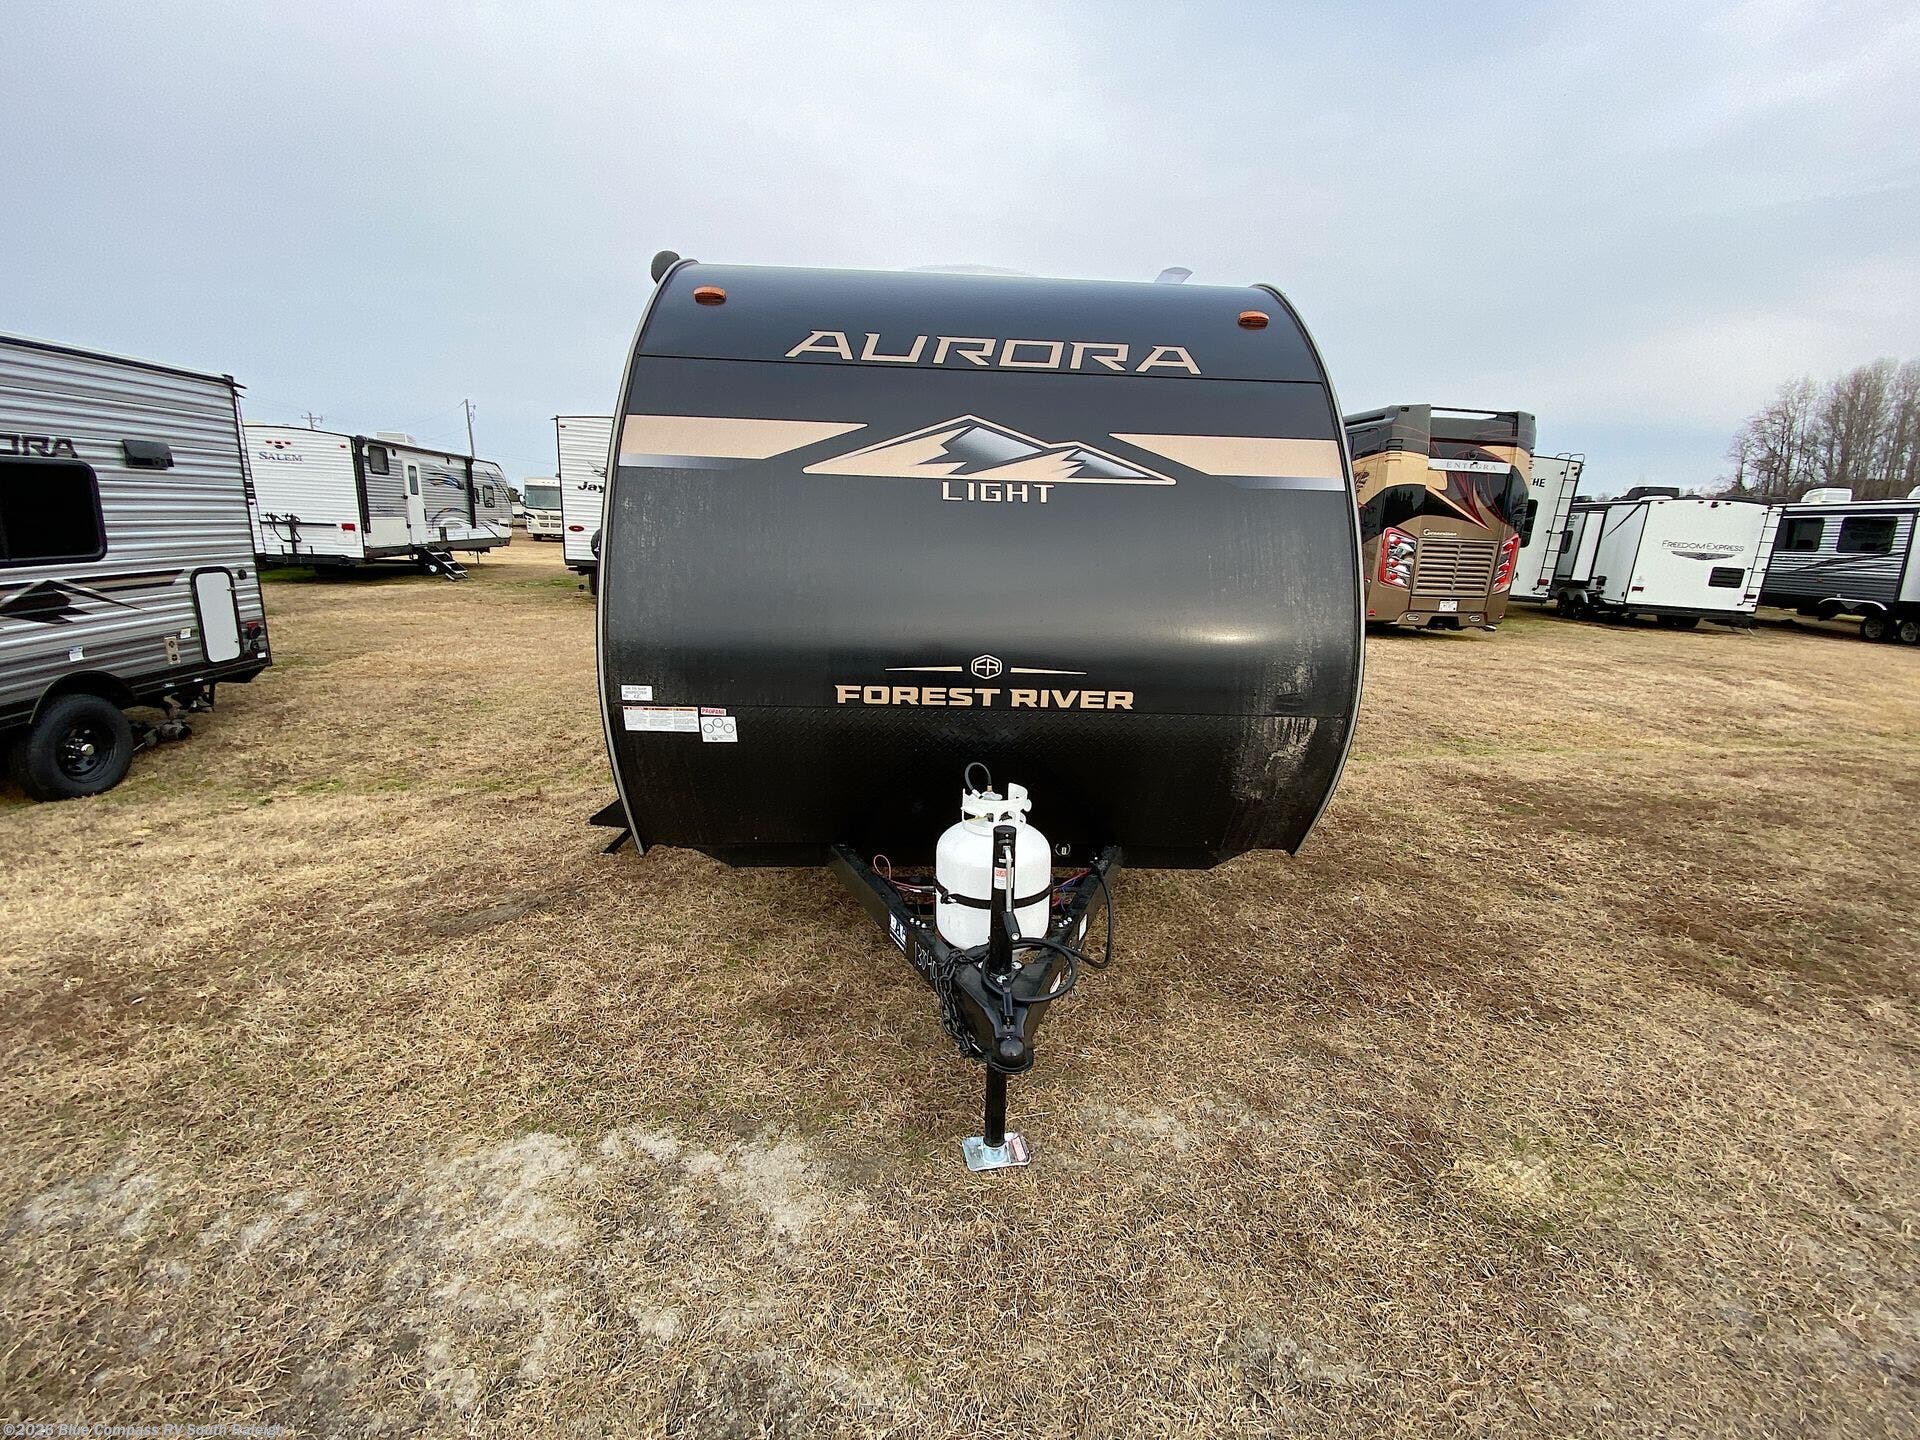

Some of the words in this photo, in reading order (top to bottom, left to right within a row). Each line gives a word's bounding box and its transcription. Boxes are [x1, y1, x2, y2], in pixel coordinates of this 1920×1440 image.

[784, 330, 1202, 375] AURORA
[259, 451, 303, 462] SALEM
[577, 481, 604, 493] Jay
[941, 481, 1055, 503] LIGHT
[834, 684, 1000, 707] FOREST
[1009, 688, 1134, 710] RIVER
